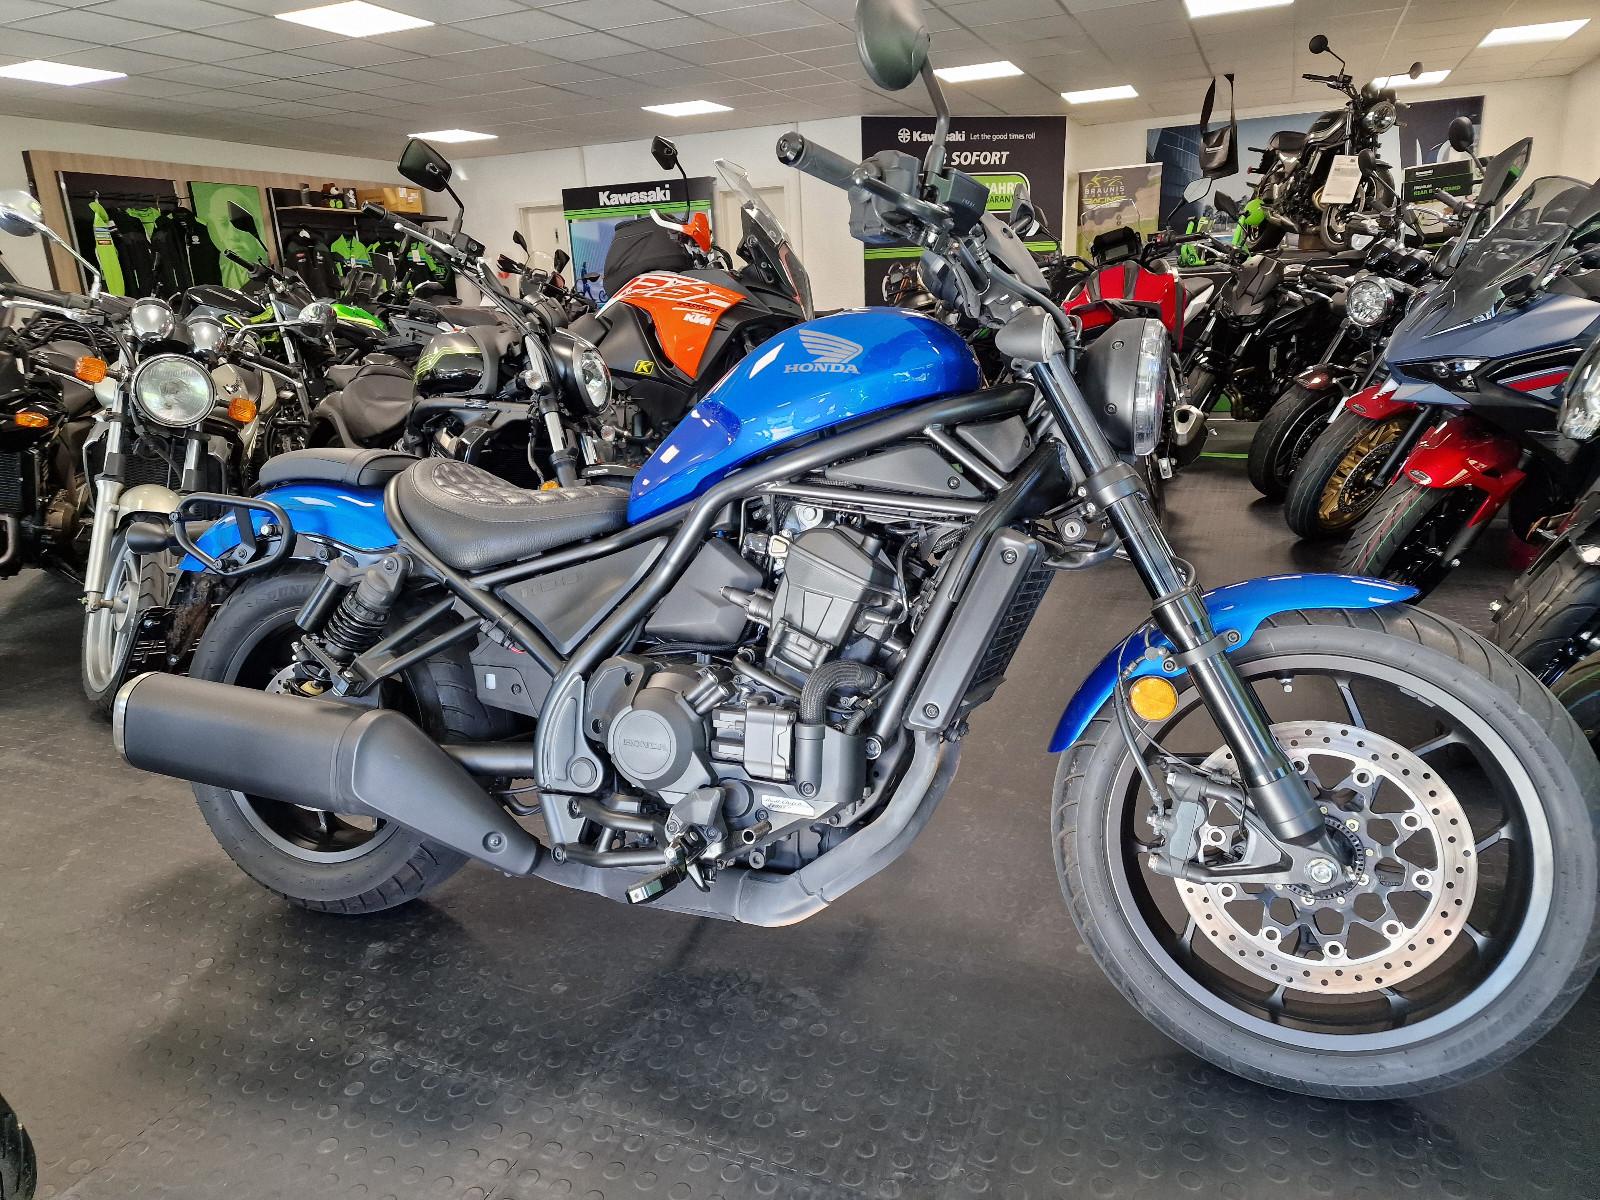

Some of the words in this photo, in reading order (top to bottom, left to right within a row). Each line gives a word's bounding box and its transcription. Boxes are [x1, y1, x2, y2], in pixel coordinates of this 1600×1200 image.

[992, 133, 1008, 142] good
[1009, 132, 1025, 140] times
[951, 151, 1009, 166] SOFORT
[598, 183, 671, 206] Kawasaki
[1084, 185, 1125, 195] BRAUNIS
[683, 312, 712, 326] KTM
[783, 363, 861, 374] HONDA
